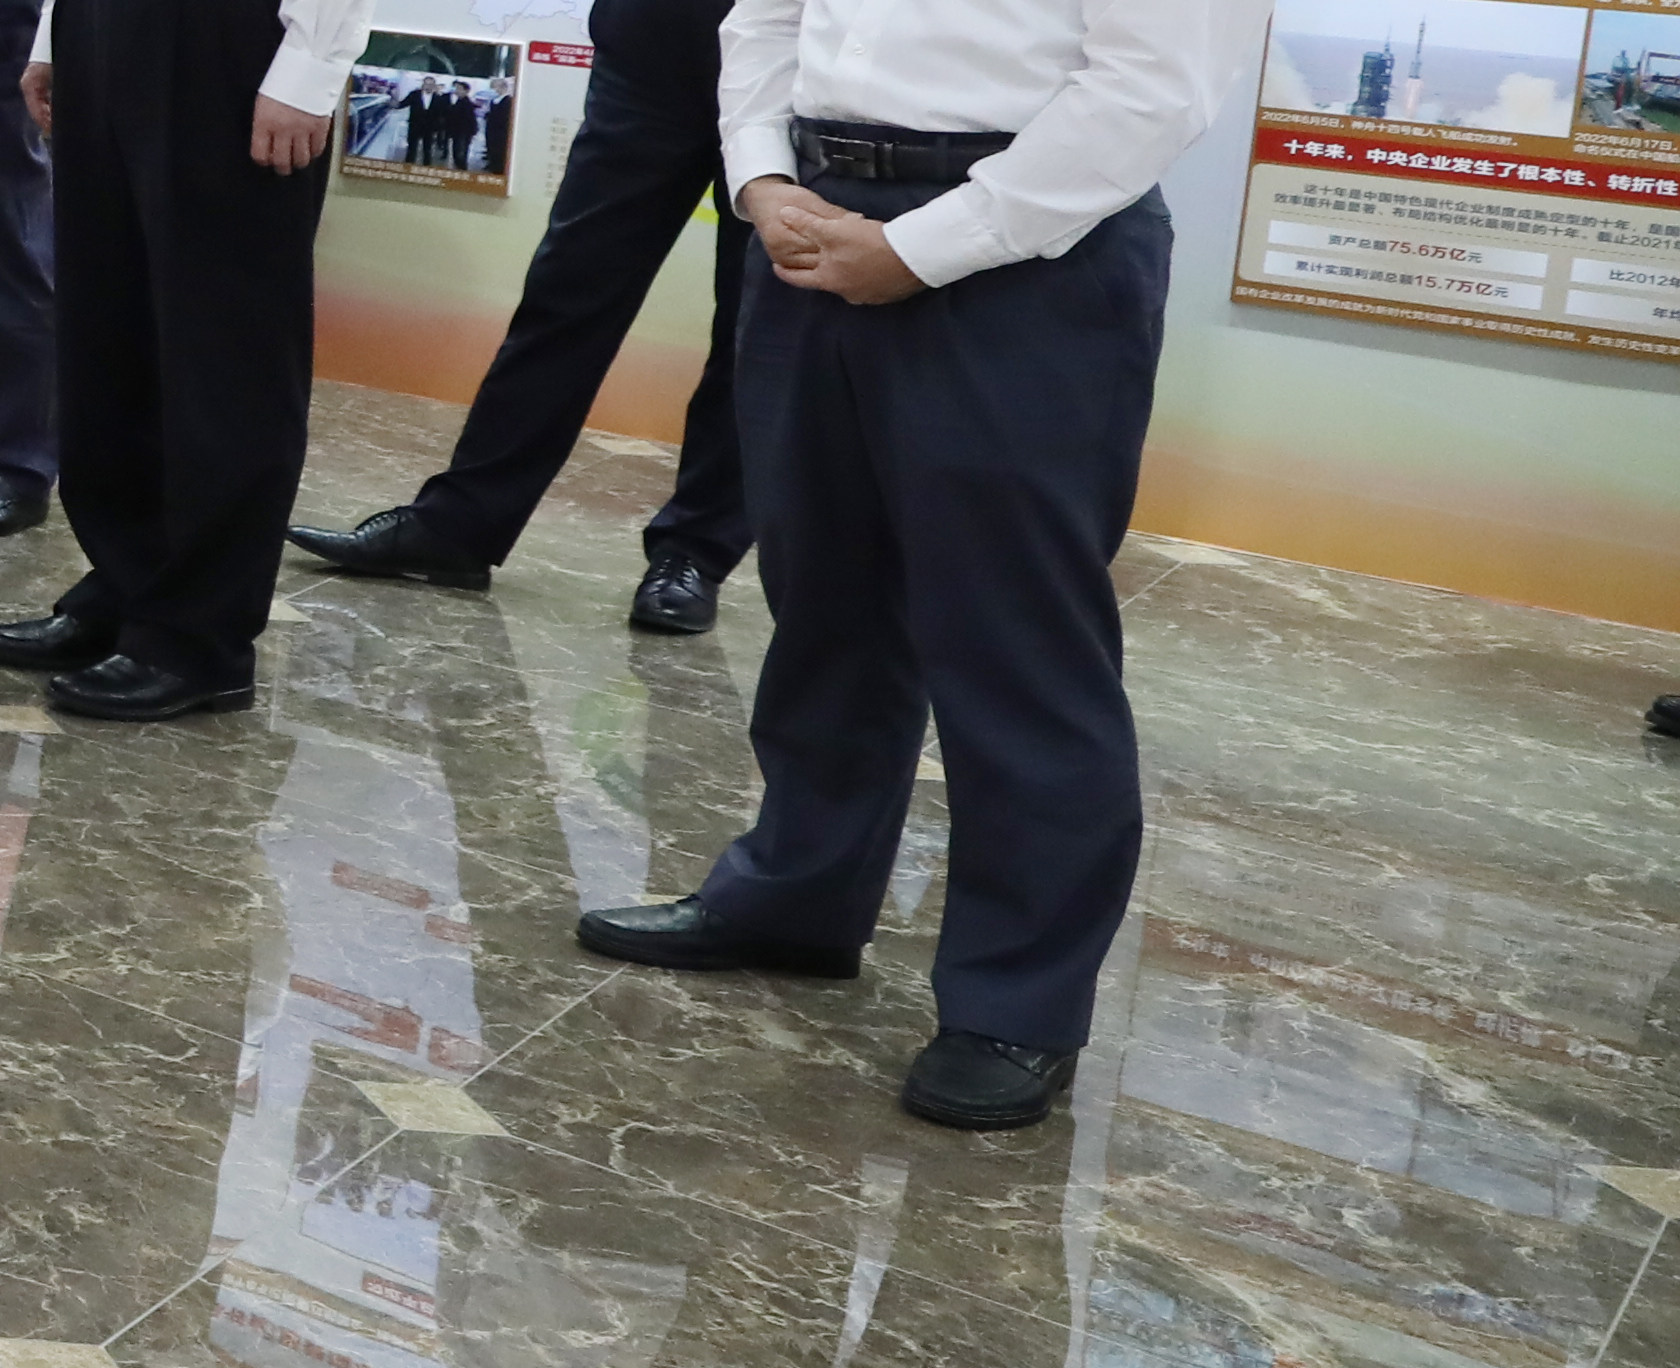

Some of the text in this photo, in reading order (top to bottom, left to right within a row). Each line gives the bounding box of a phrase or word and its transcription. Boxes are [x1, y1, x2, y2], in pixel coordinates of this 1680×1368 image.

[1282, 138, 1679, 197] 十年来，中央企业发生了根本性、转折性
[1327, 233, 1484, 264] 资产总额75.6万亿元
